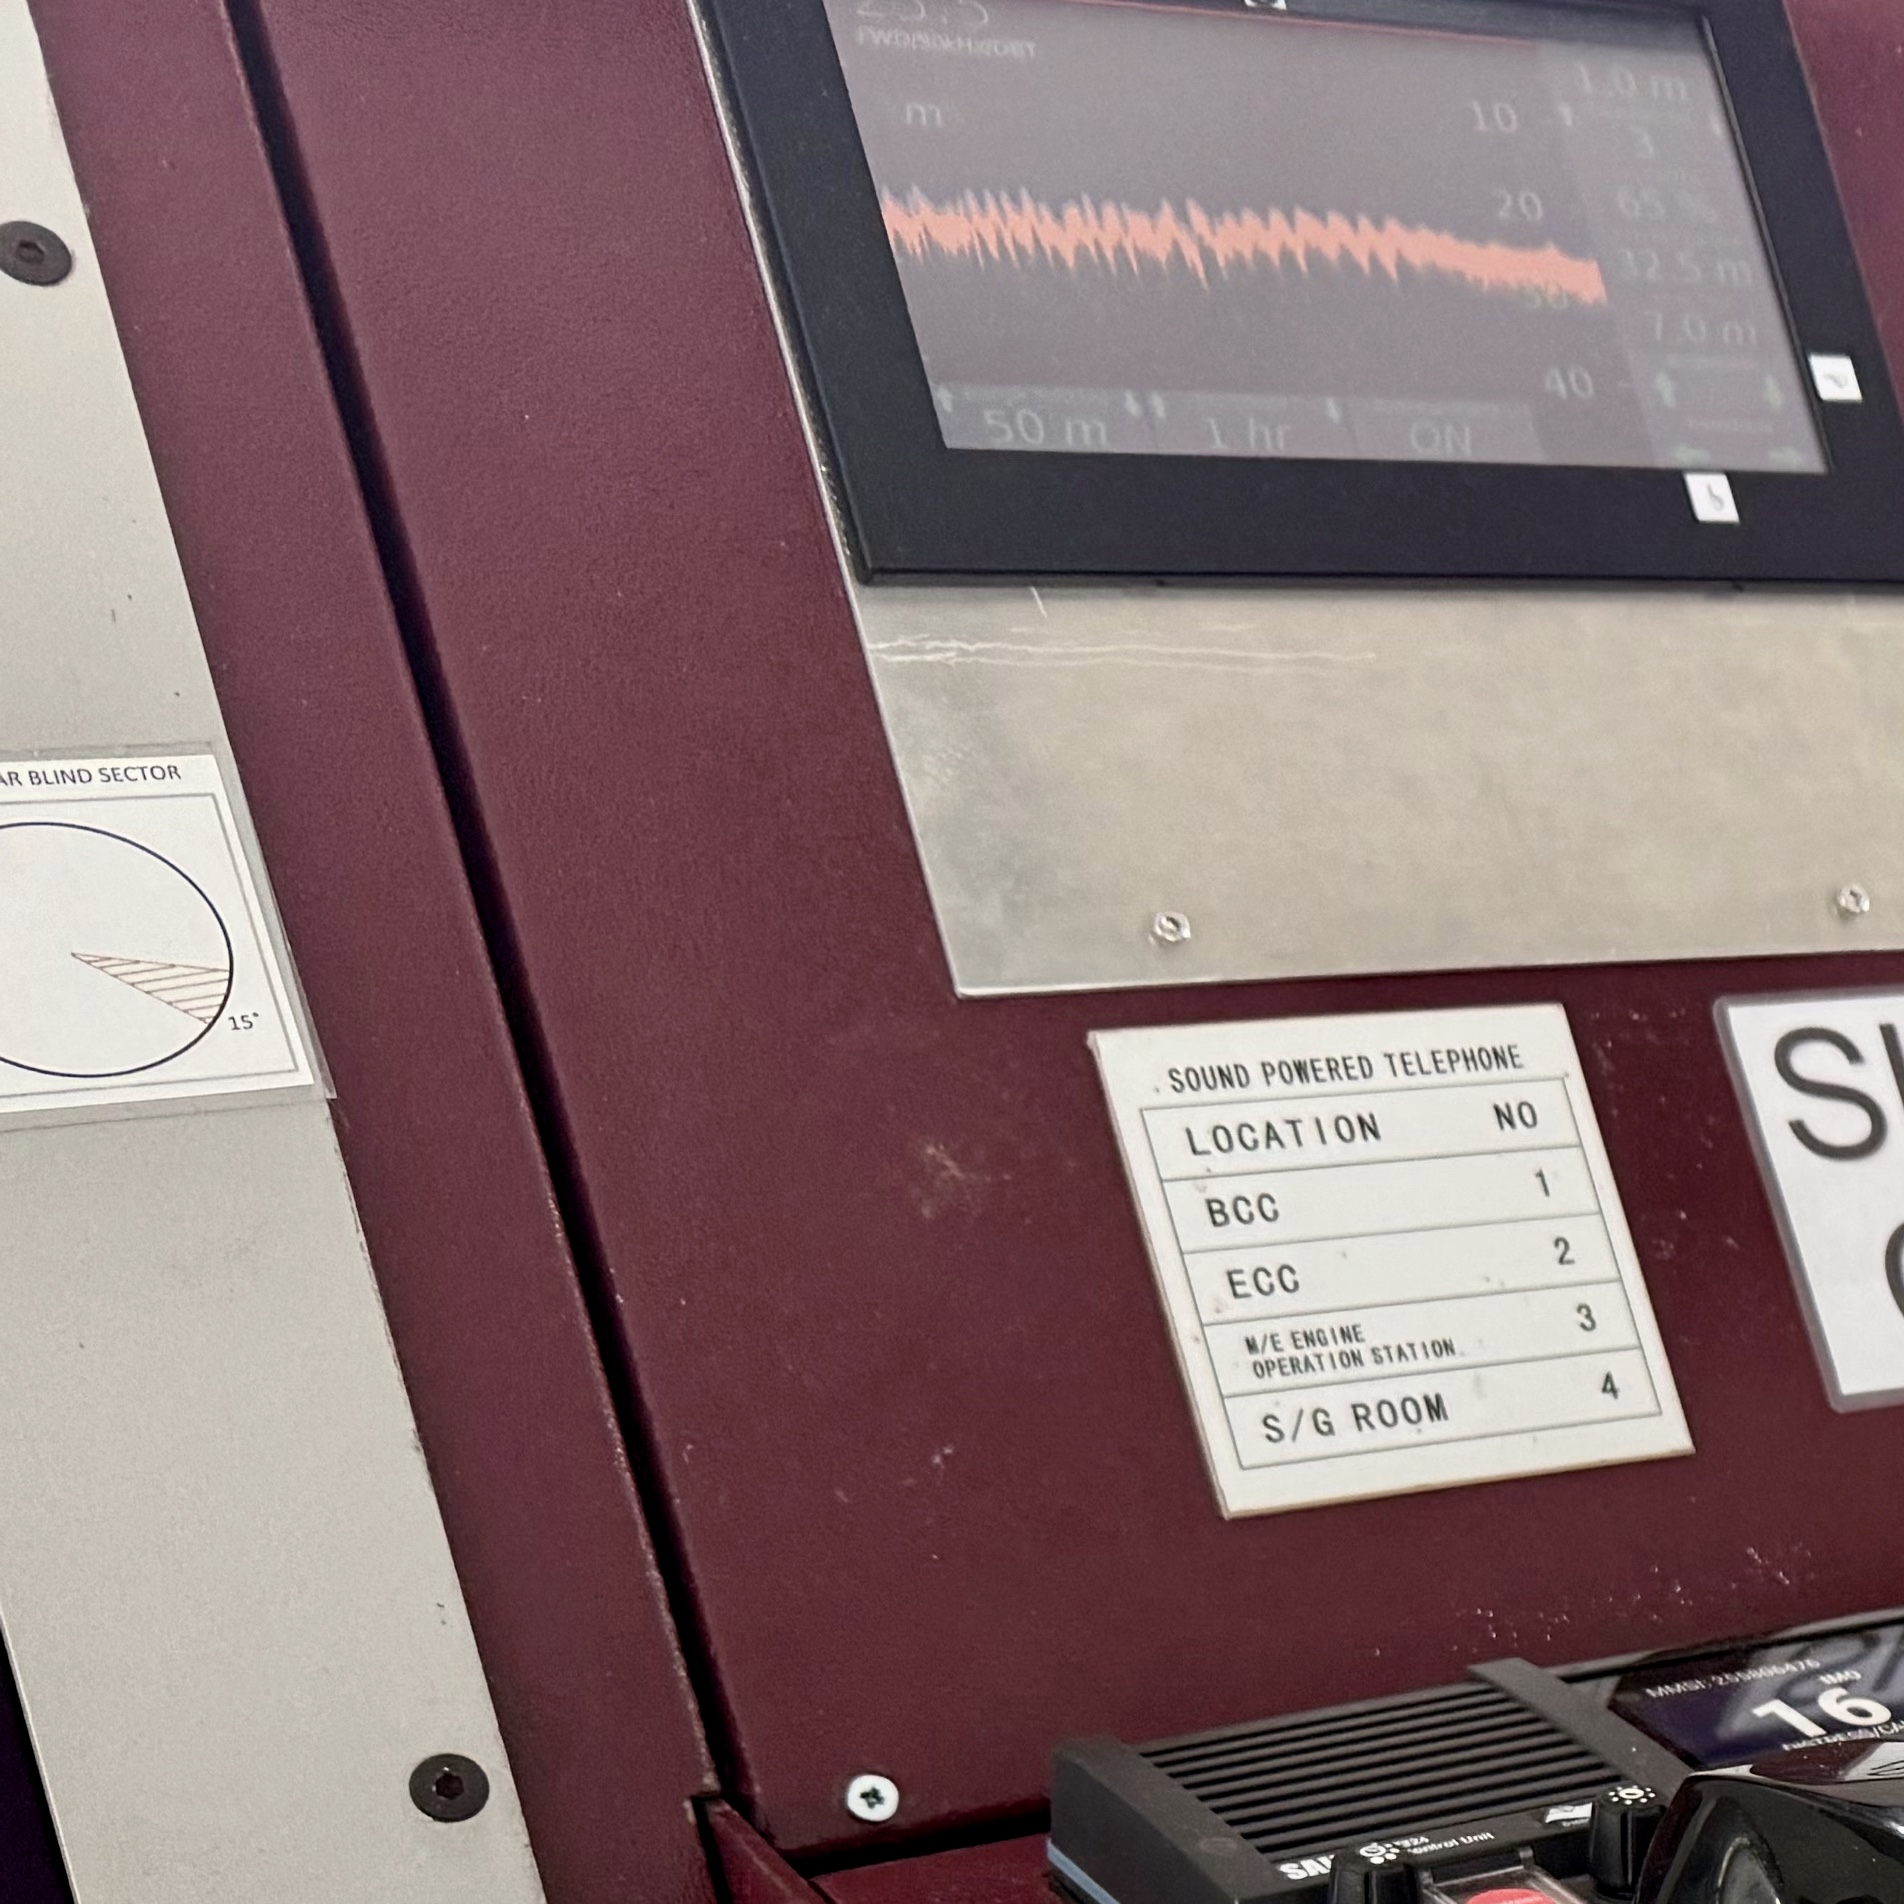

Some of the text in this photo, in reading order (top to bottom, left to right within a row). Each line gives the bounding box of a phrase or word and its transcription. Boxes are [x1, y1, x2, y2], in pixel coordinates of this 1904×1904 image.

[1470, 100, 1519, 135] 10
[1495, 192, 1544, 222] 20
[1544, 367, 1595, 400] 40
[983, 408, 1109, 447] 50 m
[1247, 416, 1290, 451] hr
[1408, 420, 1472, 456] ON
[28, 764, 182, 787] BLIND SECTOR
[1168, 1043, 1524, 1094] SOUND POWERED TELEPHONE
[1186, 1099, 1539, 1156] LOCATION NO
[1206, 1169, 1551, 1228] BCC 1
[1226, 1236, 1575, 1299] ECC 2
[1244, 1304, 1598, 1357] M/E ENGINE 3
[1252, 1338, 1457, 1380] OPERATION STATION
[1260, 1374, 1620, 1445] S/G ROOM 4
[1752, 1686, 1893, 1740] 16
